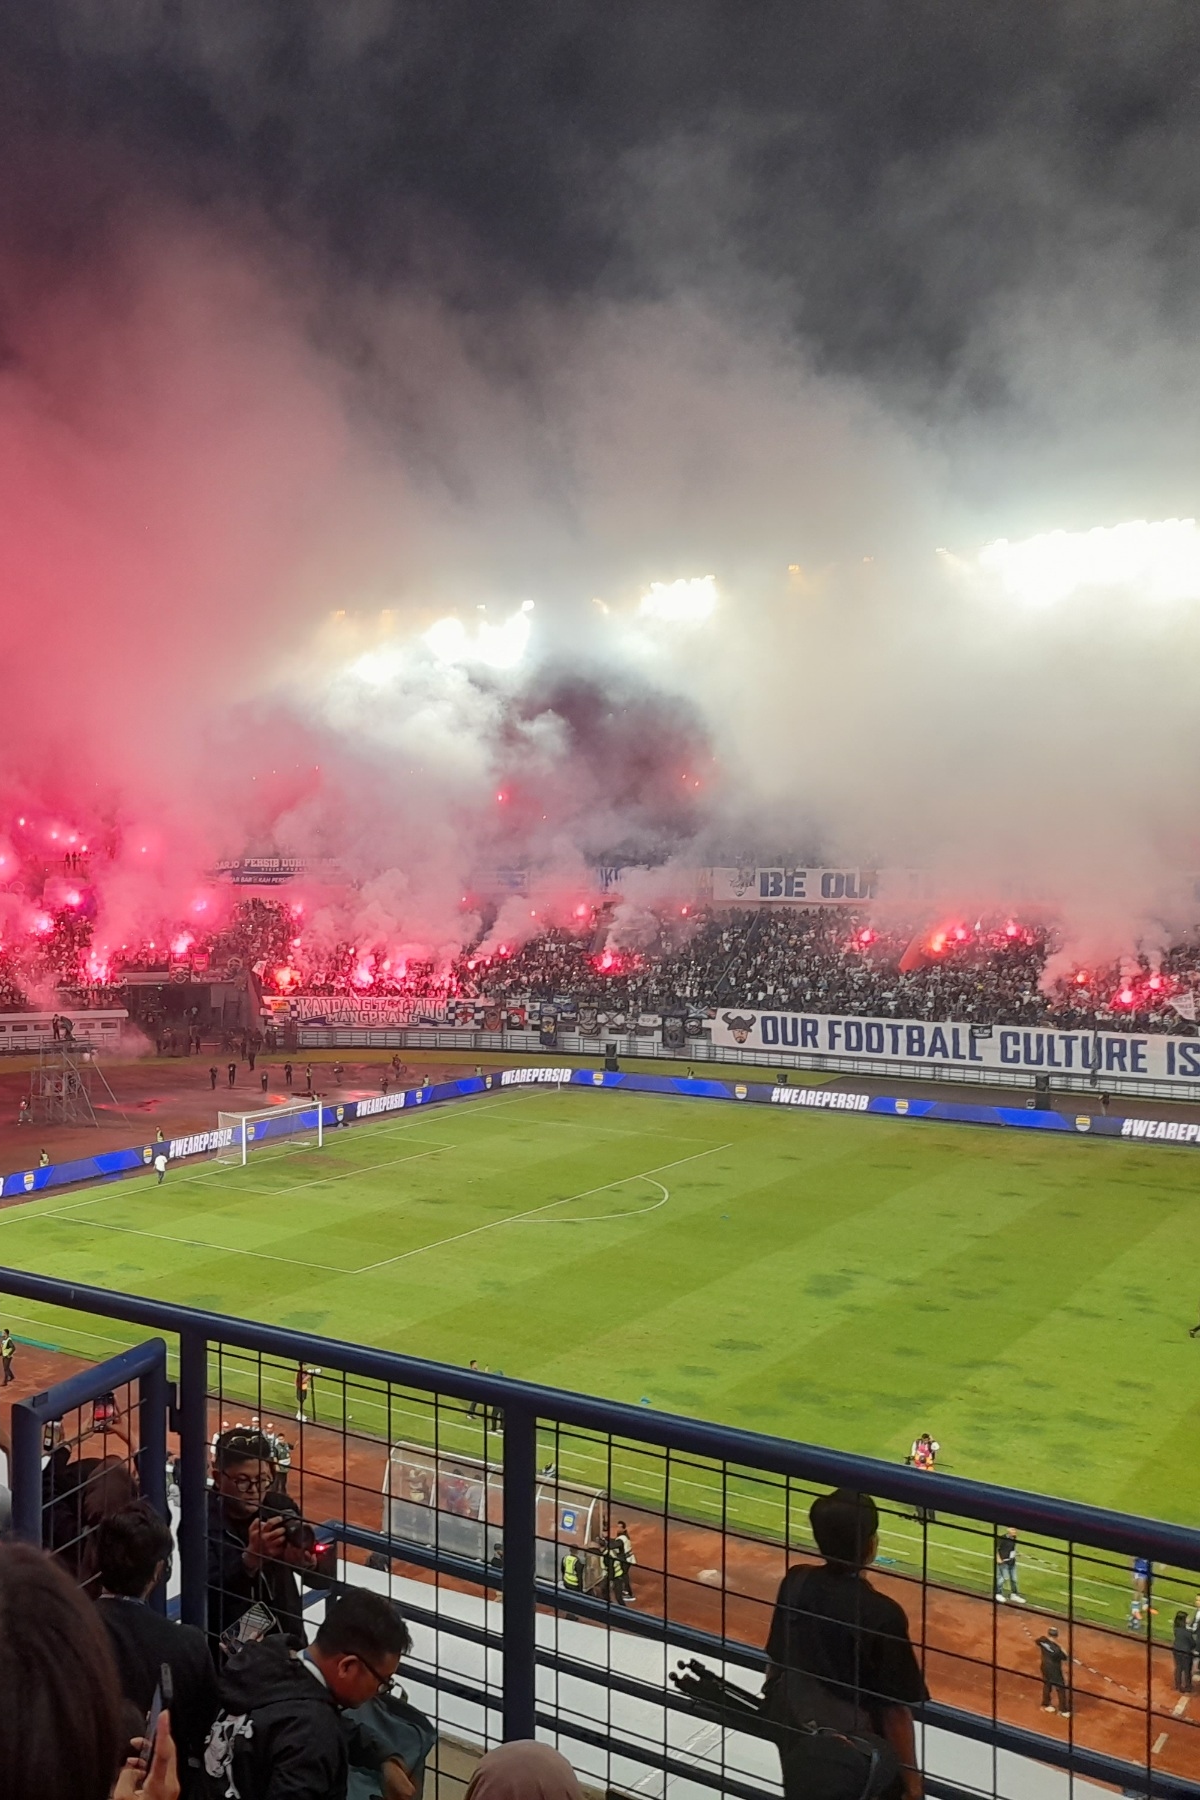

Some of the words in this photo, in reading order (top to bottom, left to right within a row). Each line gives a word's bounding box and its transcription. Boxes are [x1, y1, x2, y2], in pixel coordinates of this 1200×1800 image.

[244, 859, 279, 867] PERSIB
[759, 872, 807, 897] BE
[821, 872, 878, 899] OU
[301, 999, 371, 1020] KANDANG
[327, 1011, 418, 1023] MANGPRANG
[761, 1015, 819, 1049] OUR
[828, 1020, 983, 1062] FOOTBALL
[1000, 1031, 1148, 1073] CULTURE
[1166, 1042, 1200, 1077] IS
[501, 1068, 572, 1086] #WEAREPERSIB
[356, 1092, 406, 1118] #WEAREPERSIB
[771, 1087, 869, 1111] #WEAREPERSIB
[169, 1128, 233, 1158] #WEAREPERSIB
